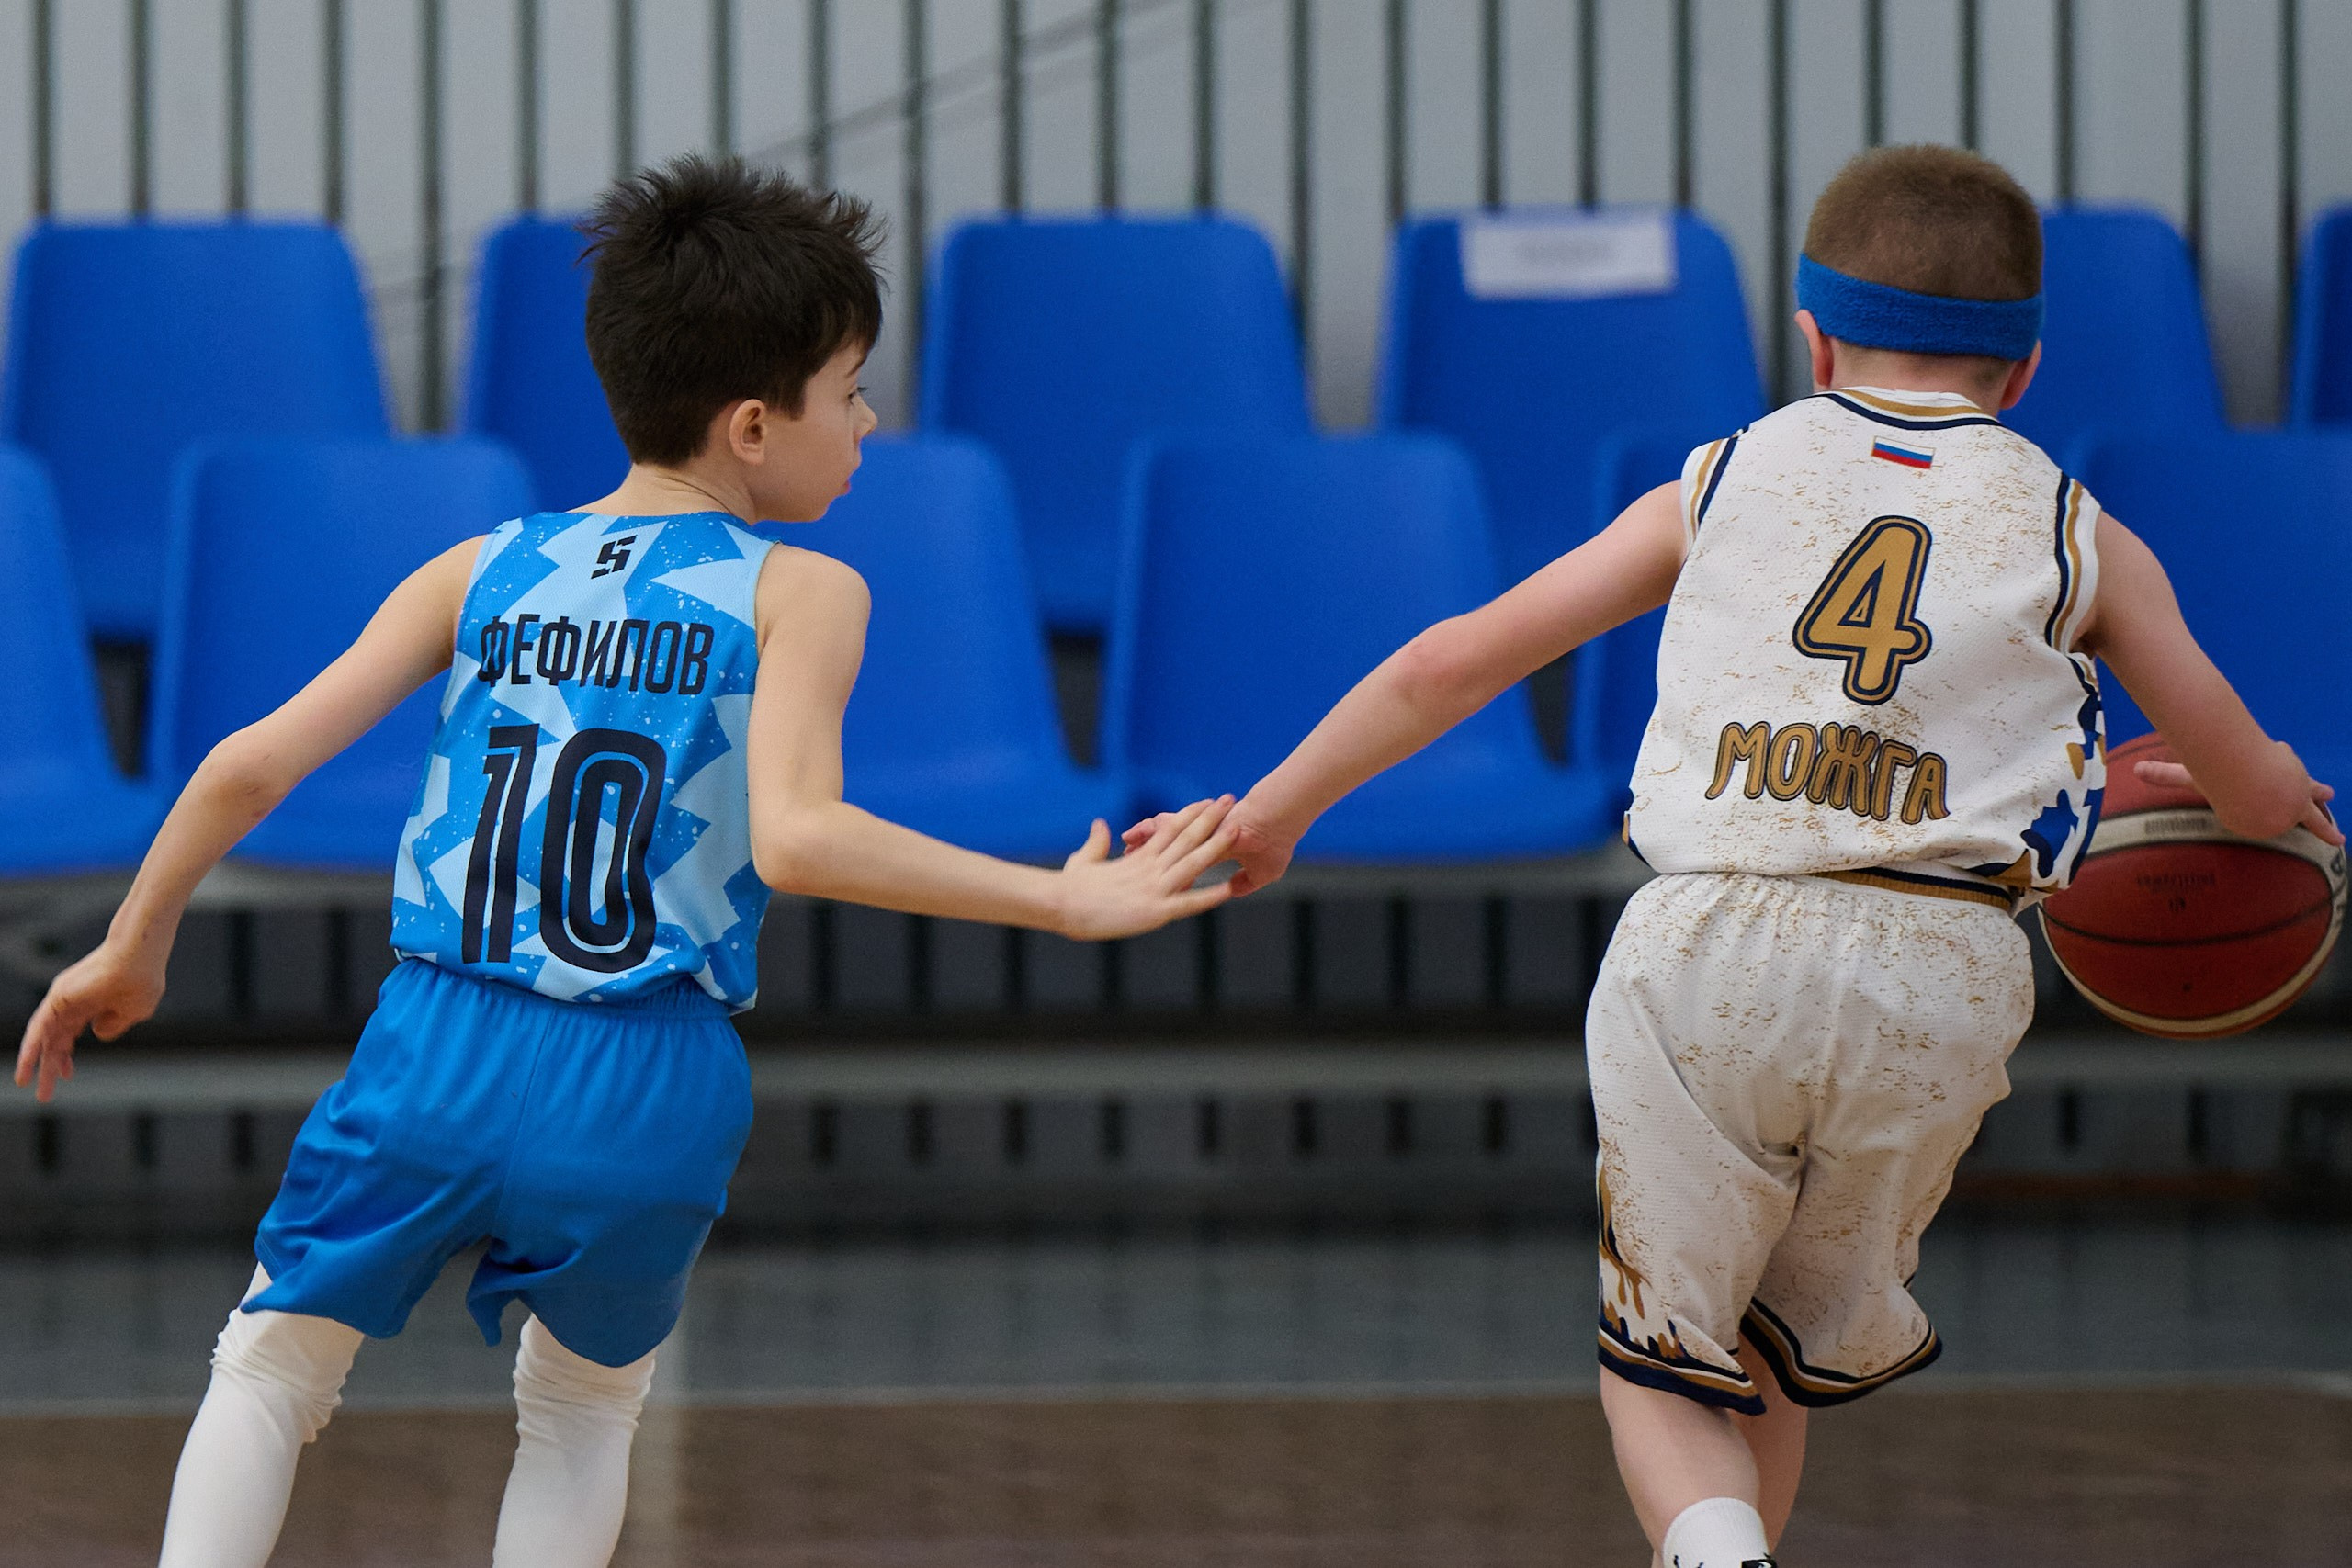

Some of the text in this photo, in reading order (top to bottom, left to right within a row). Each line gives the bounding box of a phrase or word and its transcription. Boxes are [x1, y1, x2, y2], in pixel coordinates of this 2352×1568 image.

[478, 614, 714, 695] ФЕФИЛОВ
[1792, 515, 1932, 705] 4
[1705, 721, 1951, 825] МОЖГА
[461, 723, 667, 973] 10
